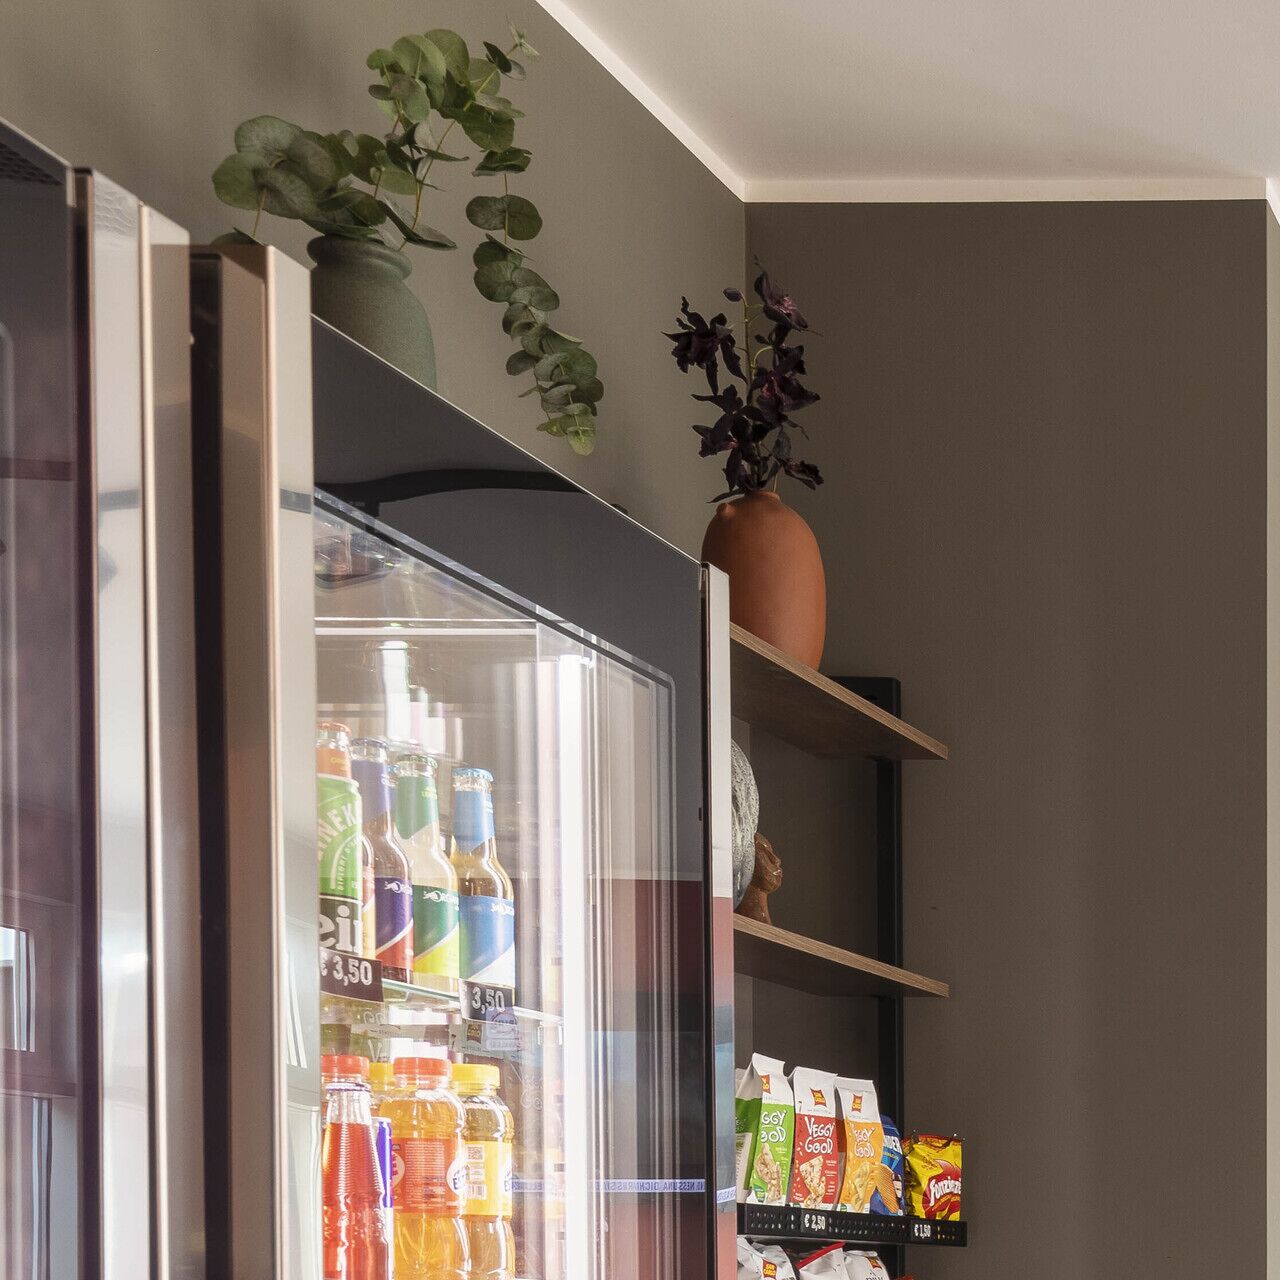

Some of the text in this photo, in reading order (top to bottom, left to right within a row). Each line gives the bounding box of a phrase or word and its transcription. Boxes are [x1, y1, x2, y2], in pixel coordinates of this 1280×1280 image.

[332, 955, 372, 986] 3,50
[472, 986, 505, 1014] 3,50
[804, 1116, 835, 1138] VEGGY
[804, 1137, 833, 1154] GOOD
[811, 1215, 826, 1231] 2,50
[919, 1224, 931, 1239] 1,50
